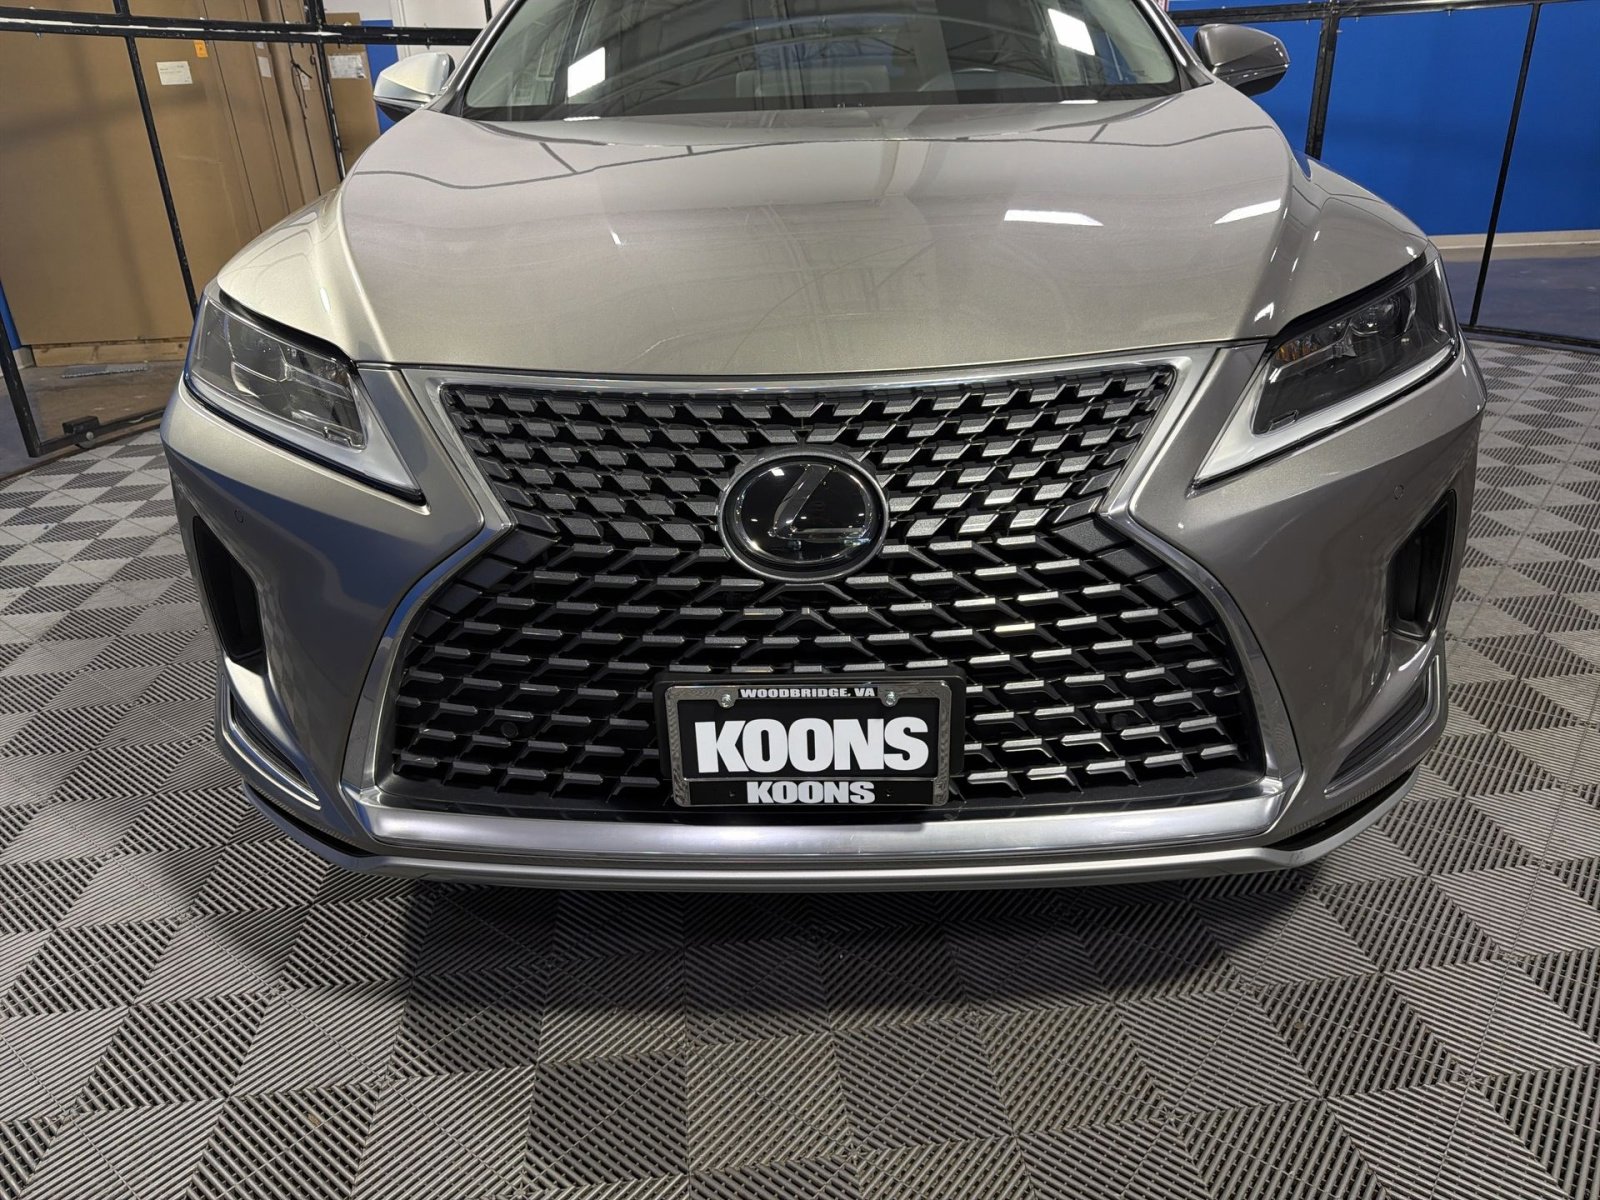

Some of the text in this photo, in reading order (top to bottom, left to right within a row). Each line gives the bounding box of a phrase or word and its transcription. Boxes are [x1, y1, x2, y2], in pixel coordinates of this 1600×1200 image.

[854, 688, 875, 697] VA
[694, 717, 929, 773] KOONS
[746, 781, 875, 804] KOONS
